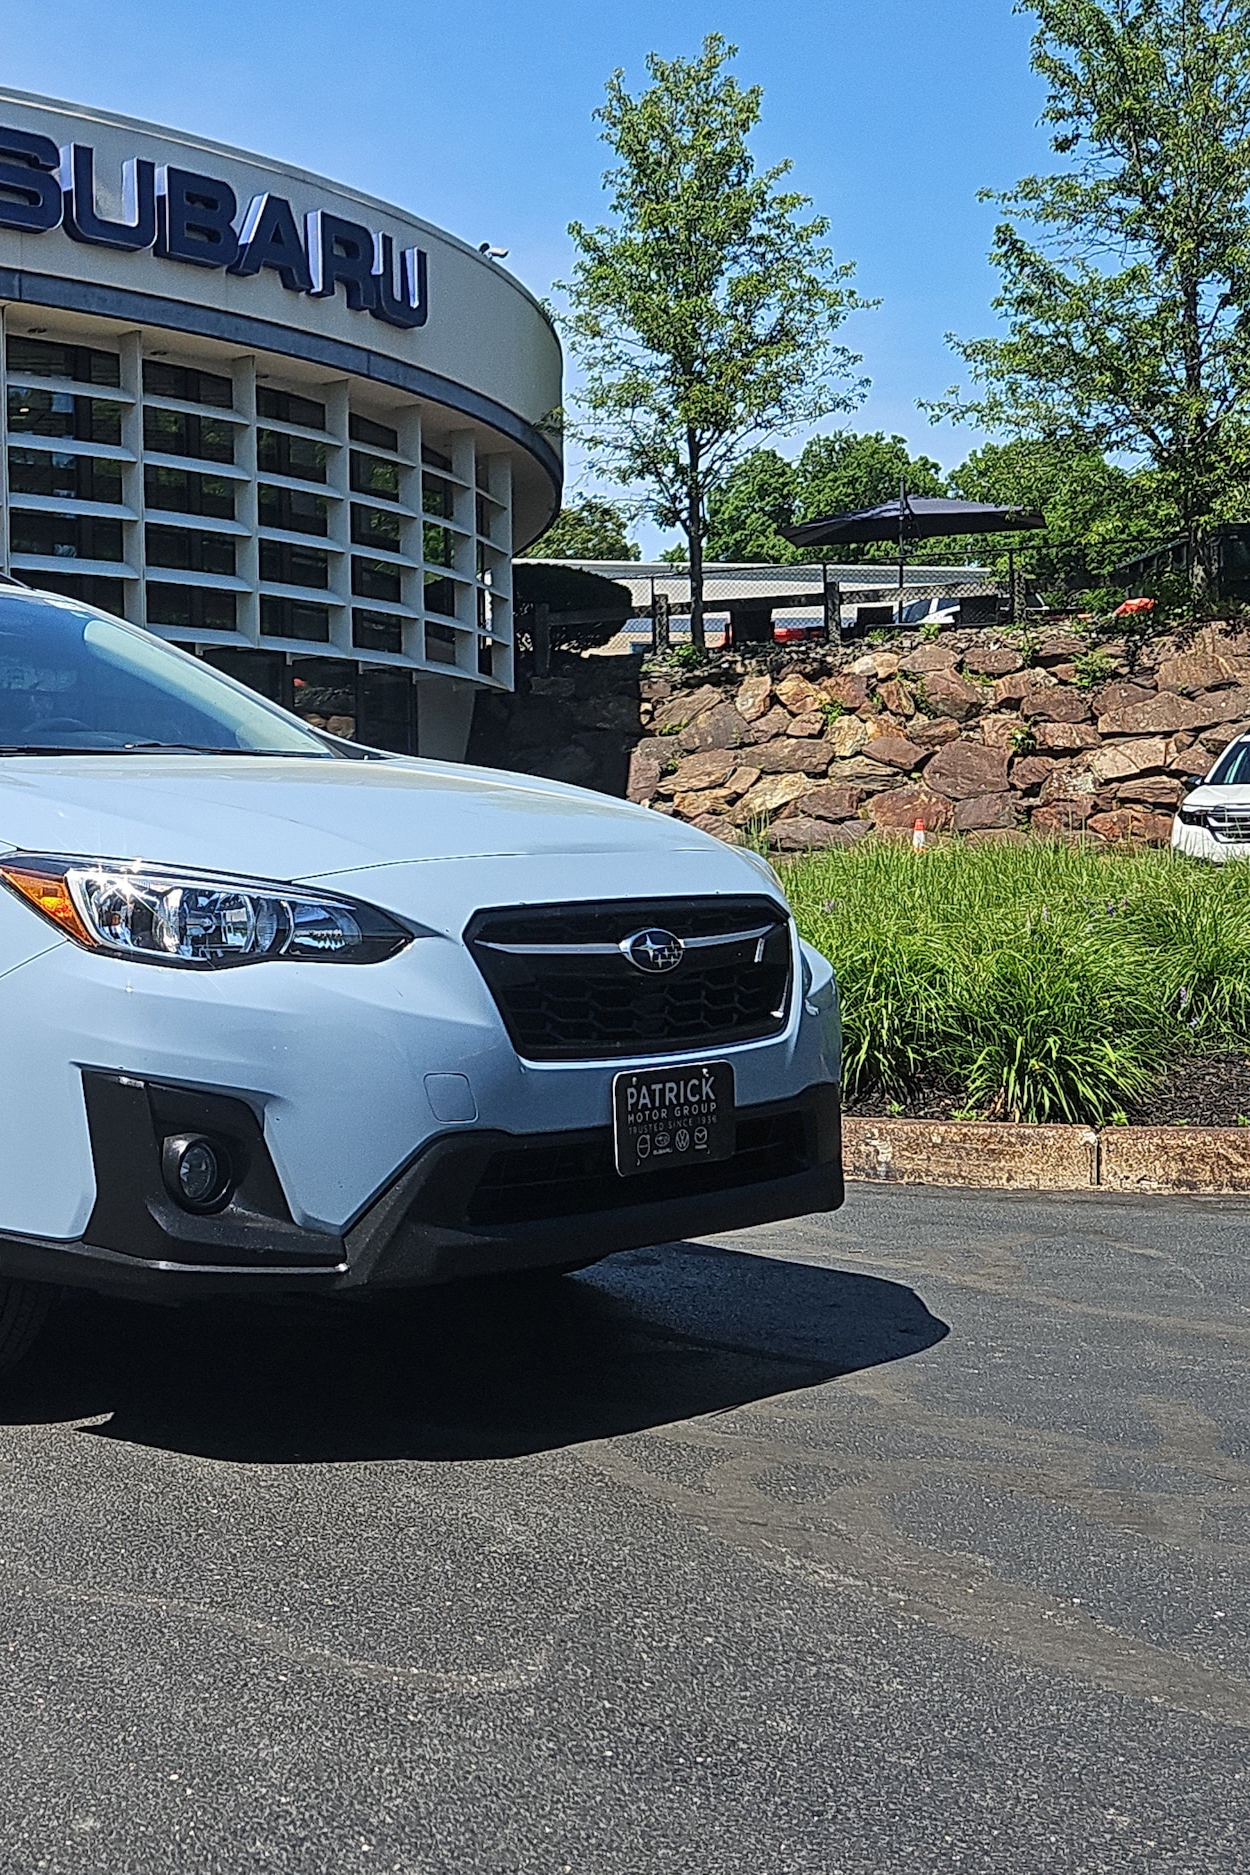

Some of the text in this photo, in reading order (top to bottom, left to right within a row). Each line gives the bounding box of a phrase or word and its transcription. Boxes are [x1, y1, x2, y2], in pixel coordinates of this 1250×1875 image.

[627, 1076, 716, 1112] PATRICK
[628, 1102, 717, 1125] MOTOR GROUP
[629, 1122, 665, 1135] TRUSTED
[668, 1118, 693, 1129] SINCE
